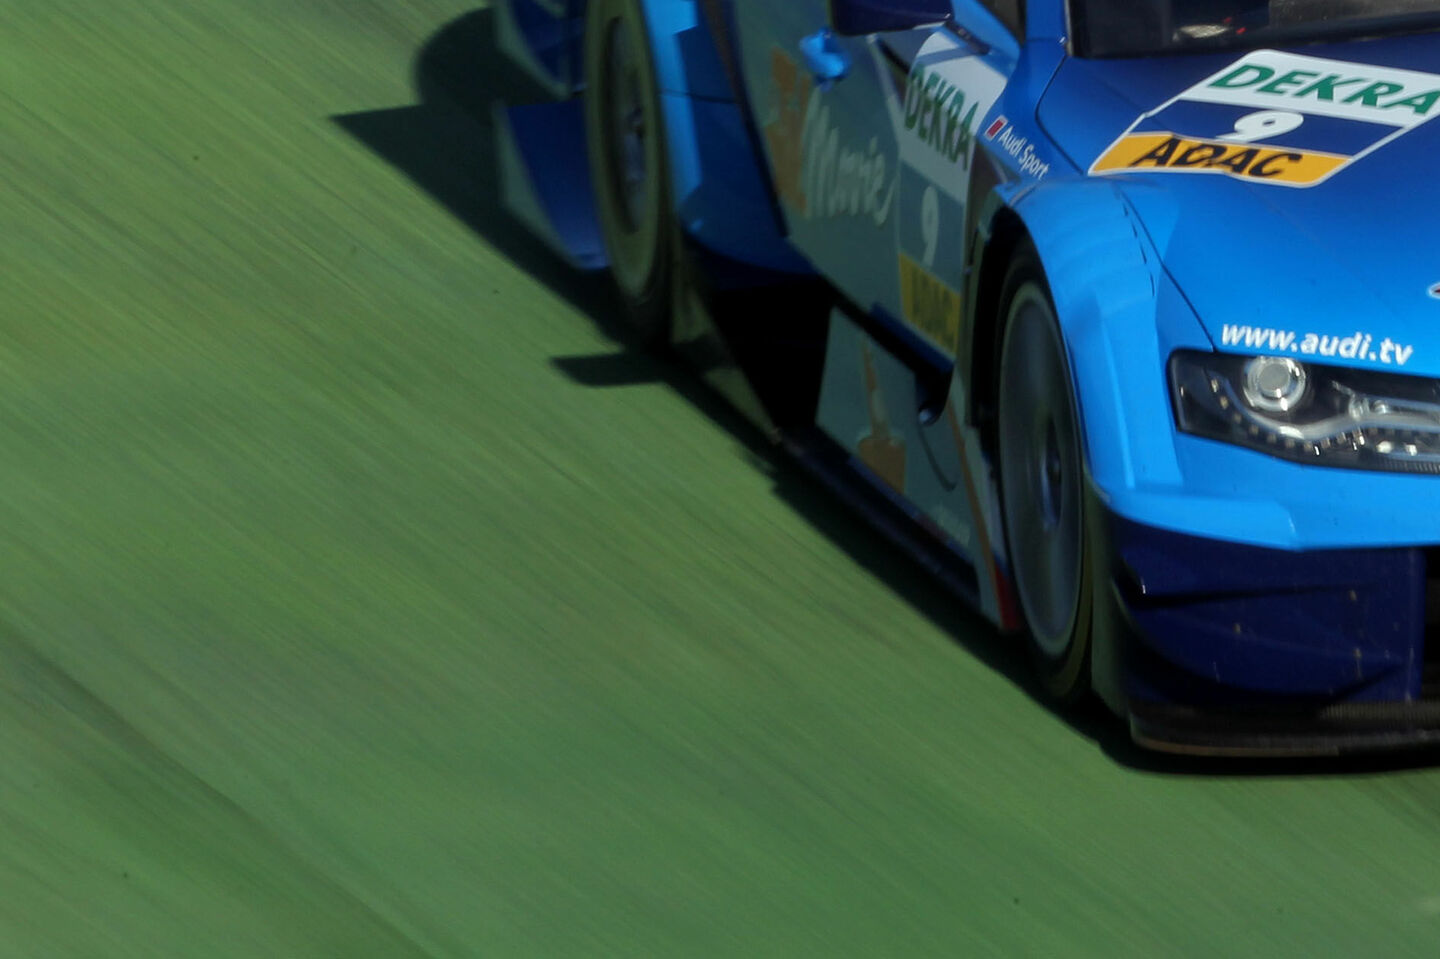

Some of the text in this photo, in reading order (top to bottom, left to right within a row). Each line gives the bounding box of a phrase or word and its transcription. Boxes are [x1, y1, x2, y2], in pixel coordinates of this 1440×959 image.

[904, 64, 980, 172] DEKRA
[1220, 109, 1305, 144] 9
[997, 125, 1050, 181] Audi Sport
[1128, 137, 1304, 178] ADAC
[1220, 323, 1414, 366] www.audi.tv
